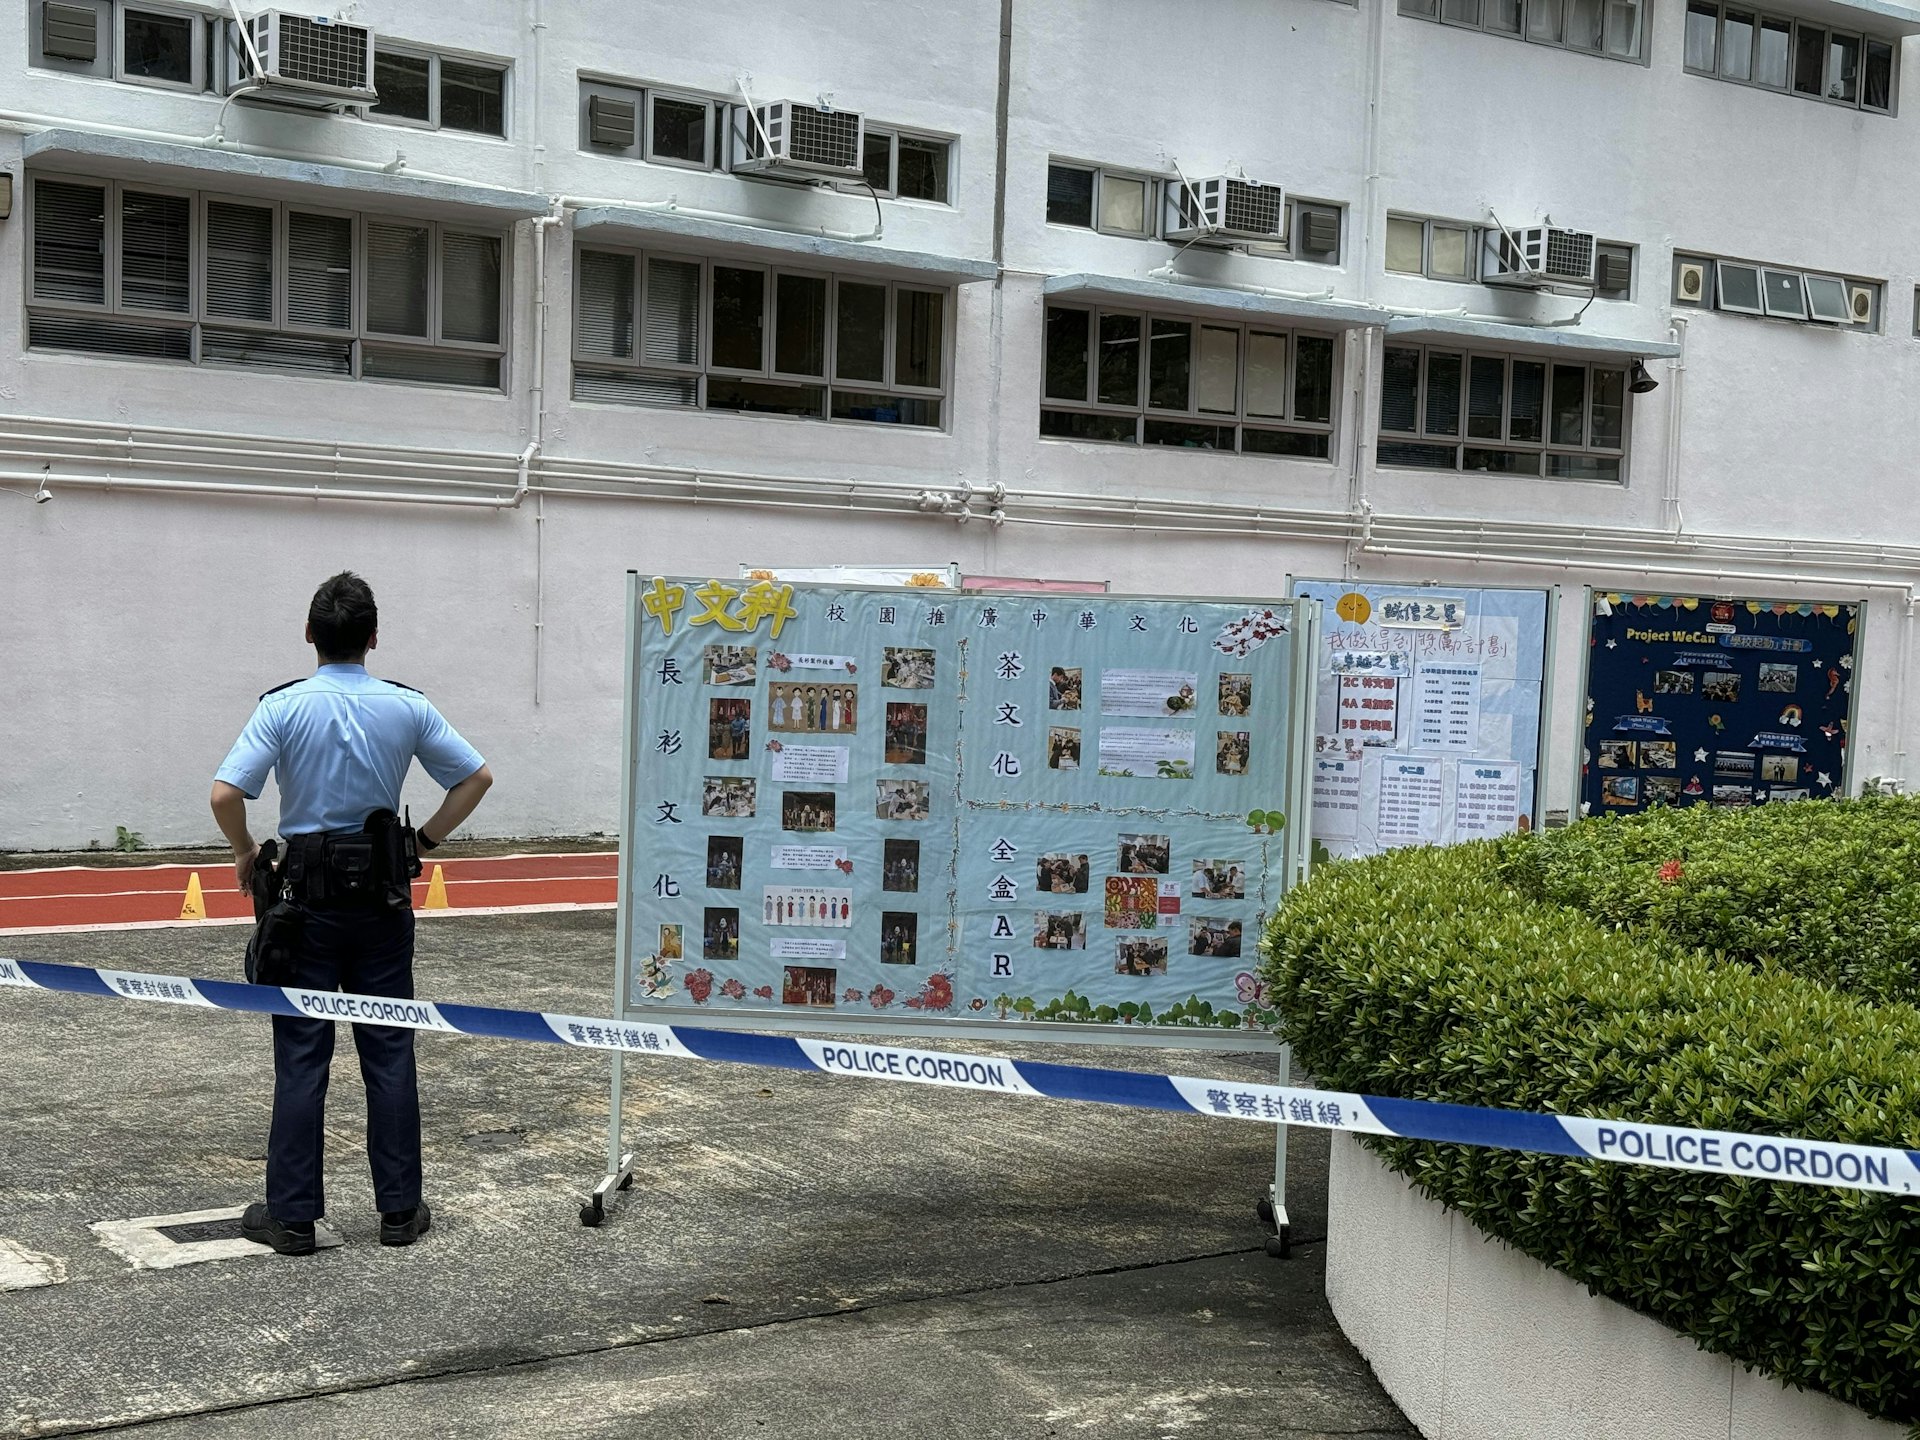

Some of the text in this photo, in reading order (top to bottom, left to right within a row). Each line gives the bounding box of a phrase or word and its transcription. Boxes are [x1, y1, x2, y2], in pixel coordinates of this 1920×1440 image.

[642, 579, 796, 637] 中文科
[827, 604, 1199, 633] 校園推廣中華文化
[1627, 628, 1716, 645] Project WeCan
[1343, 677, 1359, 688] 2C
[993, 653, 1024, 775] 茶文化
[1342, 698, 1358, 708] 4A
[654, 657, 683, 897] 長衫文化
[301, 994, 360, 1017] POLICE
[823, 1047, 902, 1076] POLICE
[1600, 1126, 1722, 1168] POLICE
